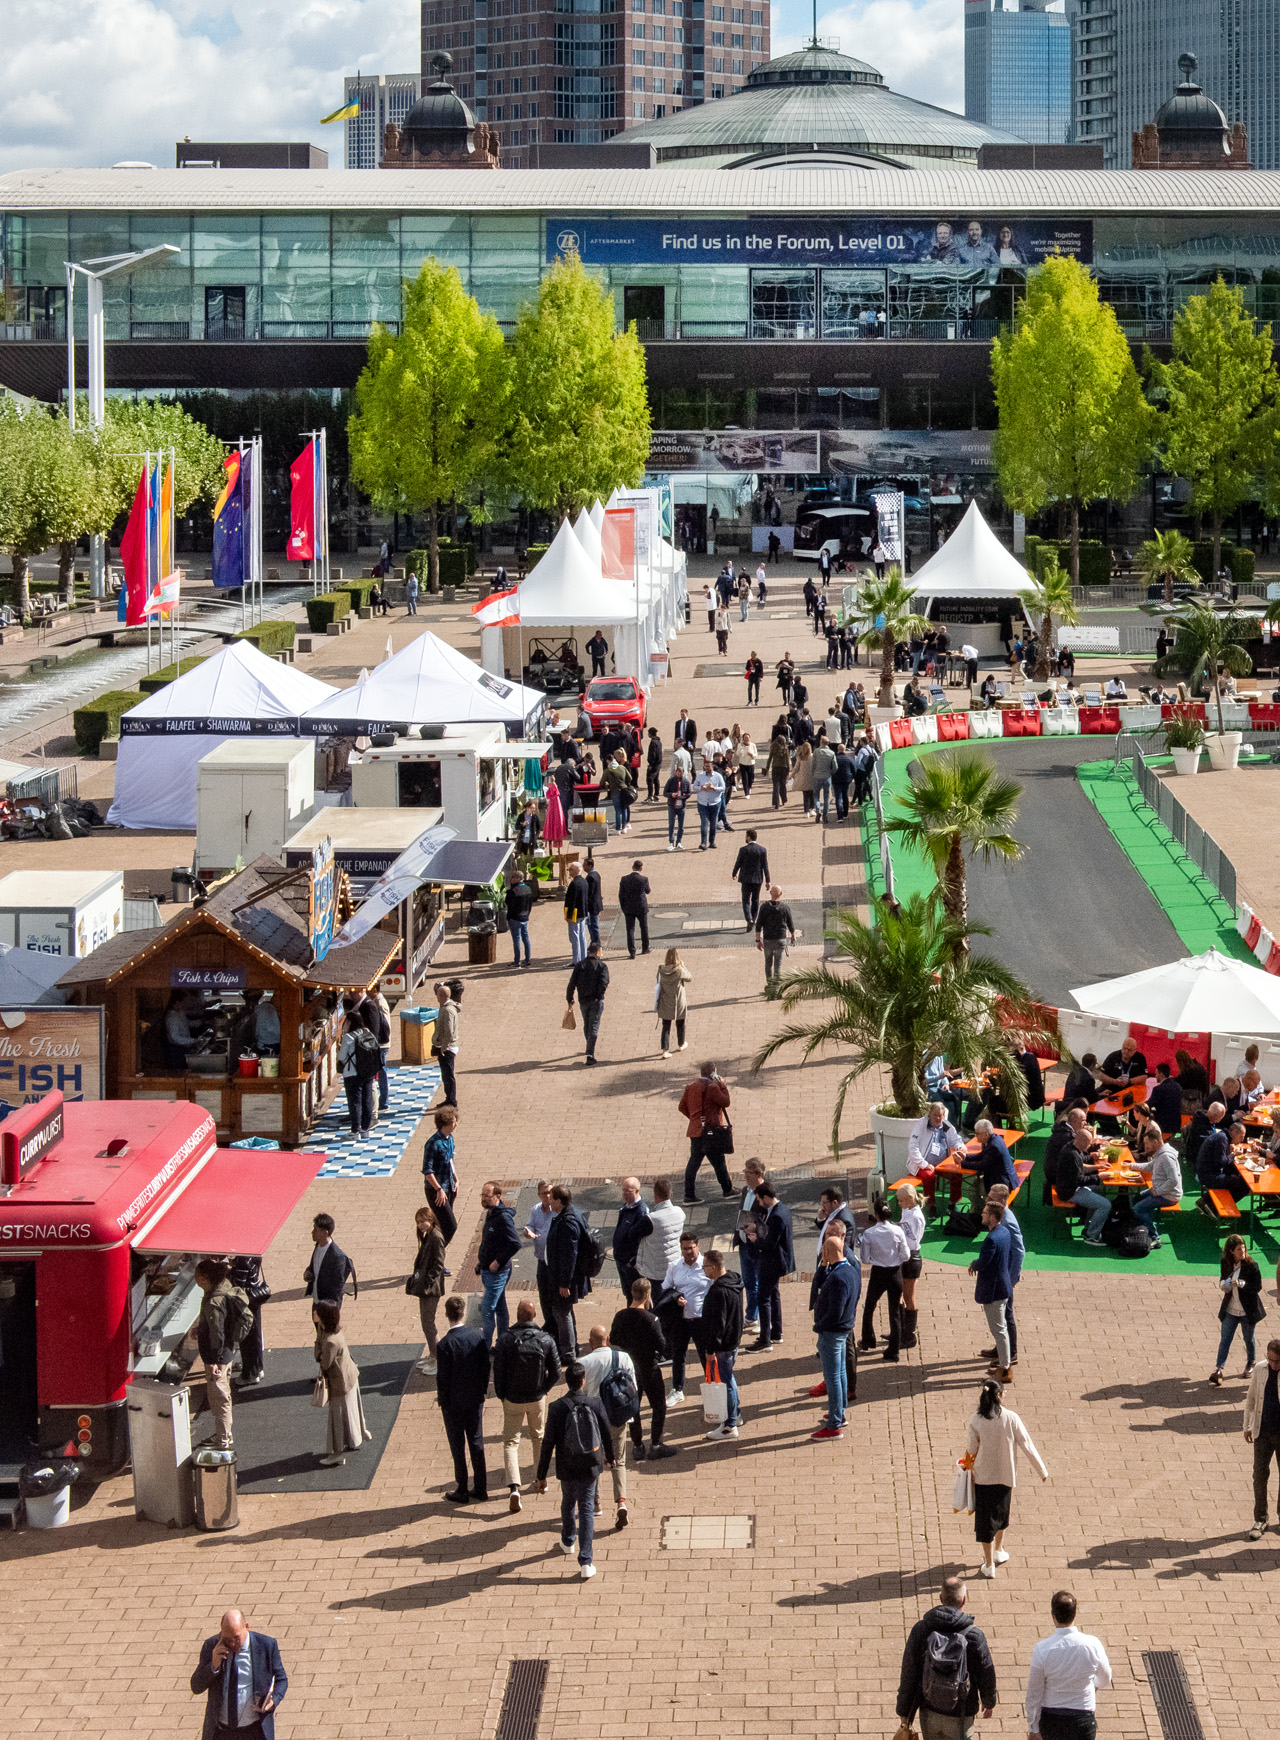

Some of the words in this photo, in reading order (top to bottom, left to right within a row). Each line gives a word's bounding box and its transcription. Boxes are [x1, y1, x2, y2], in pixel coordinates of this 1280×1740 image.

[662, 234, 698, 249] Find
[702, 238, 722, 249] us
[726, 234, 741, 249] in
[746, 235, 772, 249] the
[777, 234, 834, 252] Forum,
[838, 234, 882, 250] Level
[886, 234, 906, 250] 01
[166, 720, 196, 731] FALAFEL
[206, 719, 251, 731] SHAWARMA
[423, 836, 439, 852] FISH
[385, 887, 401, 902] FISH
[178, 970, 201, 983] Fish
[203, 972, 212, 983] &
[213, 971, 239, 986] Chips
[29, 1036, 82, 1057] Fresh
[23, 1094, 47, 1105] AN
[20, 1113, 62, 1166] CURRYWURST
[0, 1224, 91, 1239] STSNACKS
